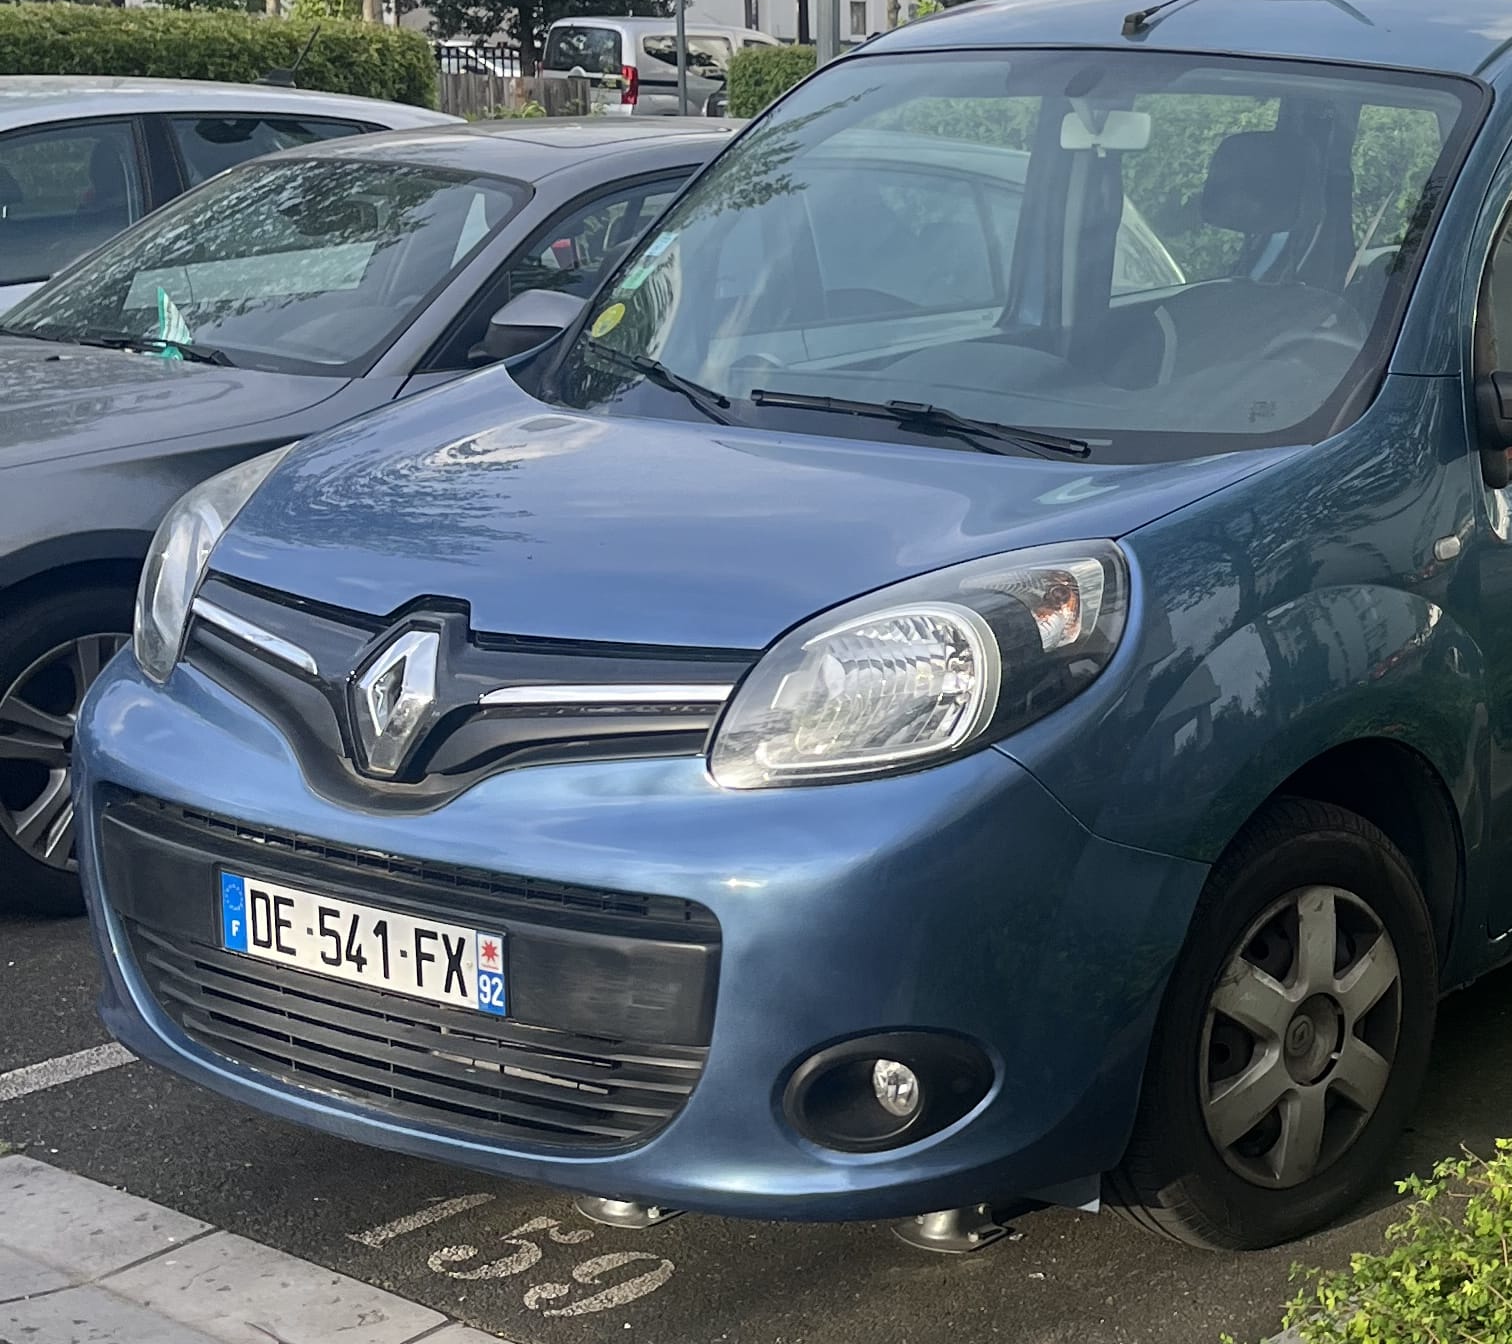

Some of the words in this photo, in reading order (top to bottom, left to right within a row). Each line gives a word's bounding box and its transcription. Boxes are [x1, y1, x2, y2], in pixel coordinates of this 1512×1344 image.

[231, 919, 240, 937] F
[250, 889, 467, 997] DE-541-FX
[479, 974, 504, 1007] 92
[346, 1192, 676, 1317] 159
